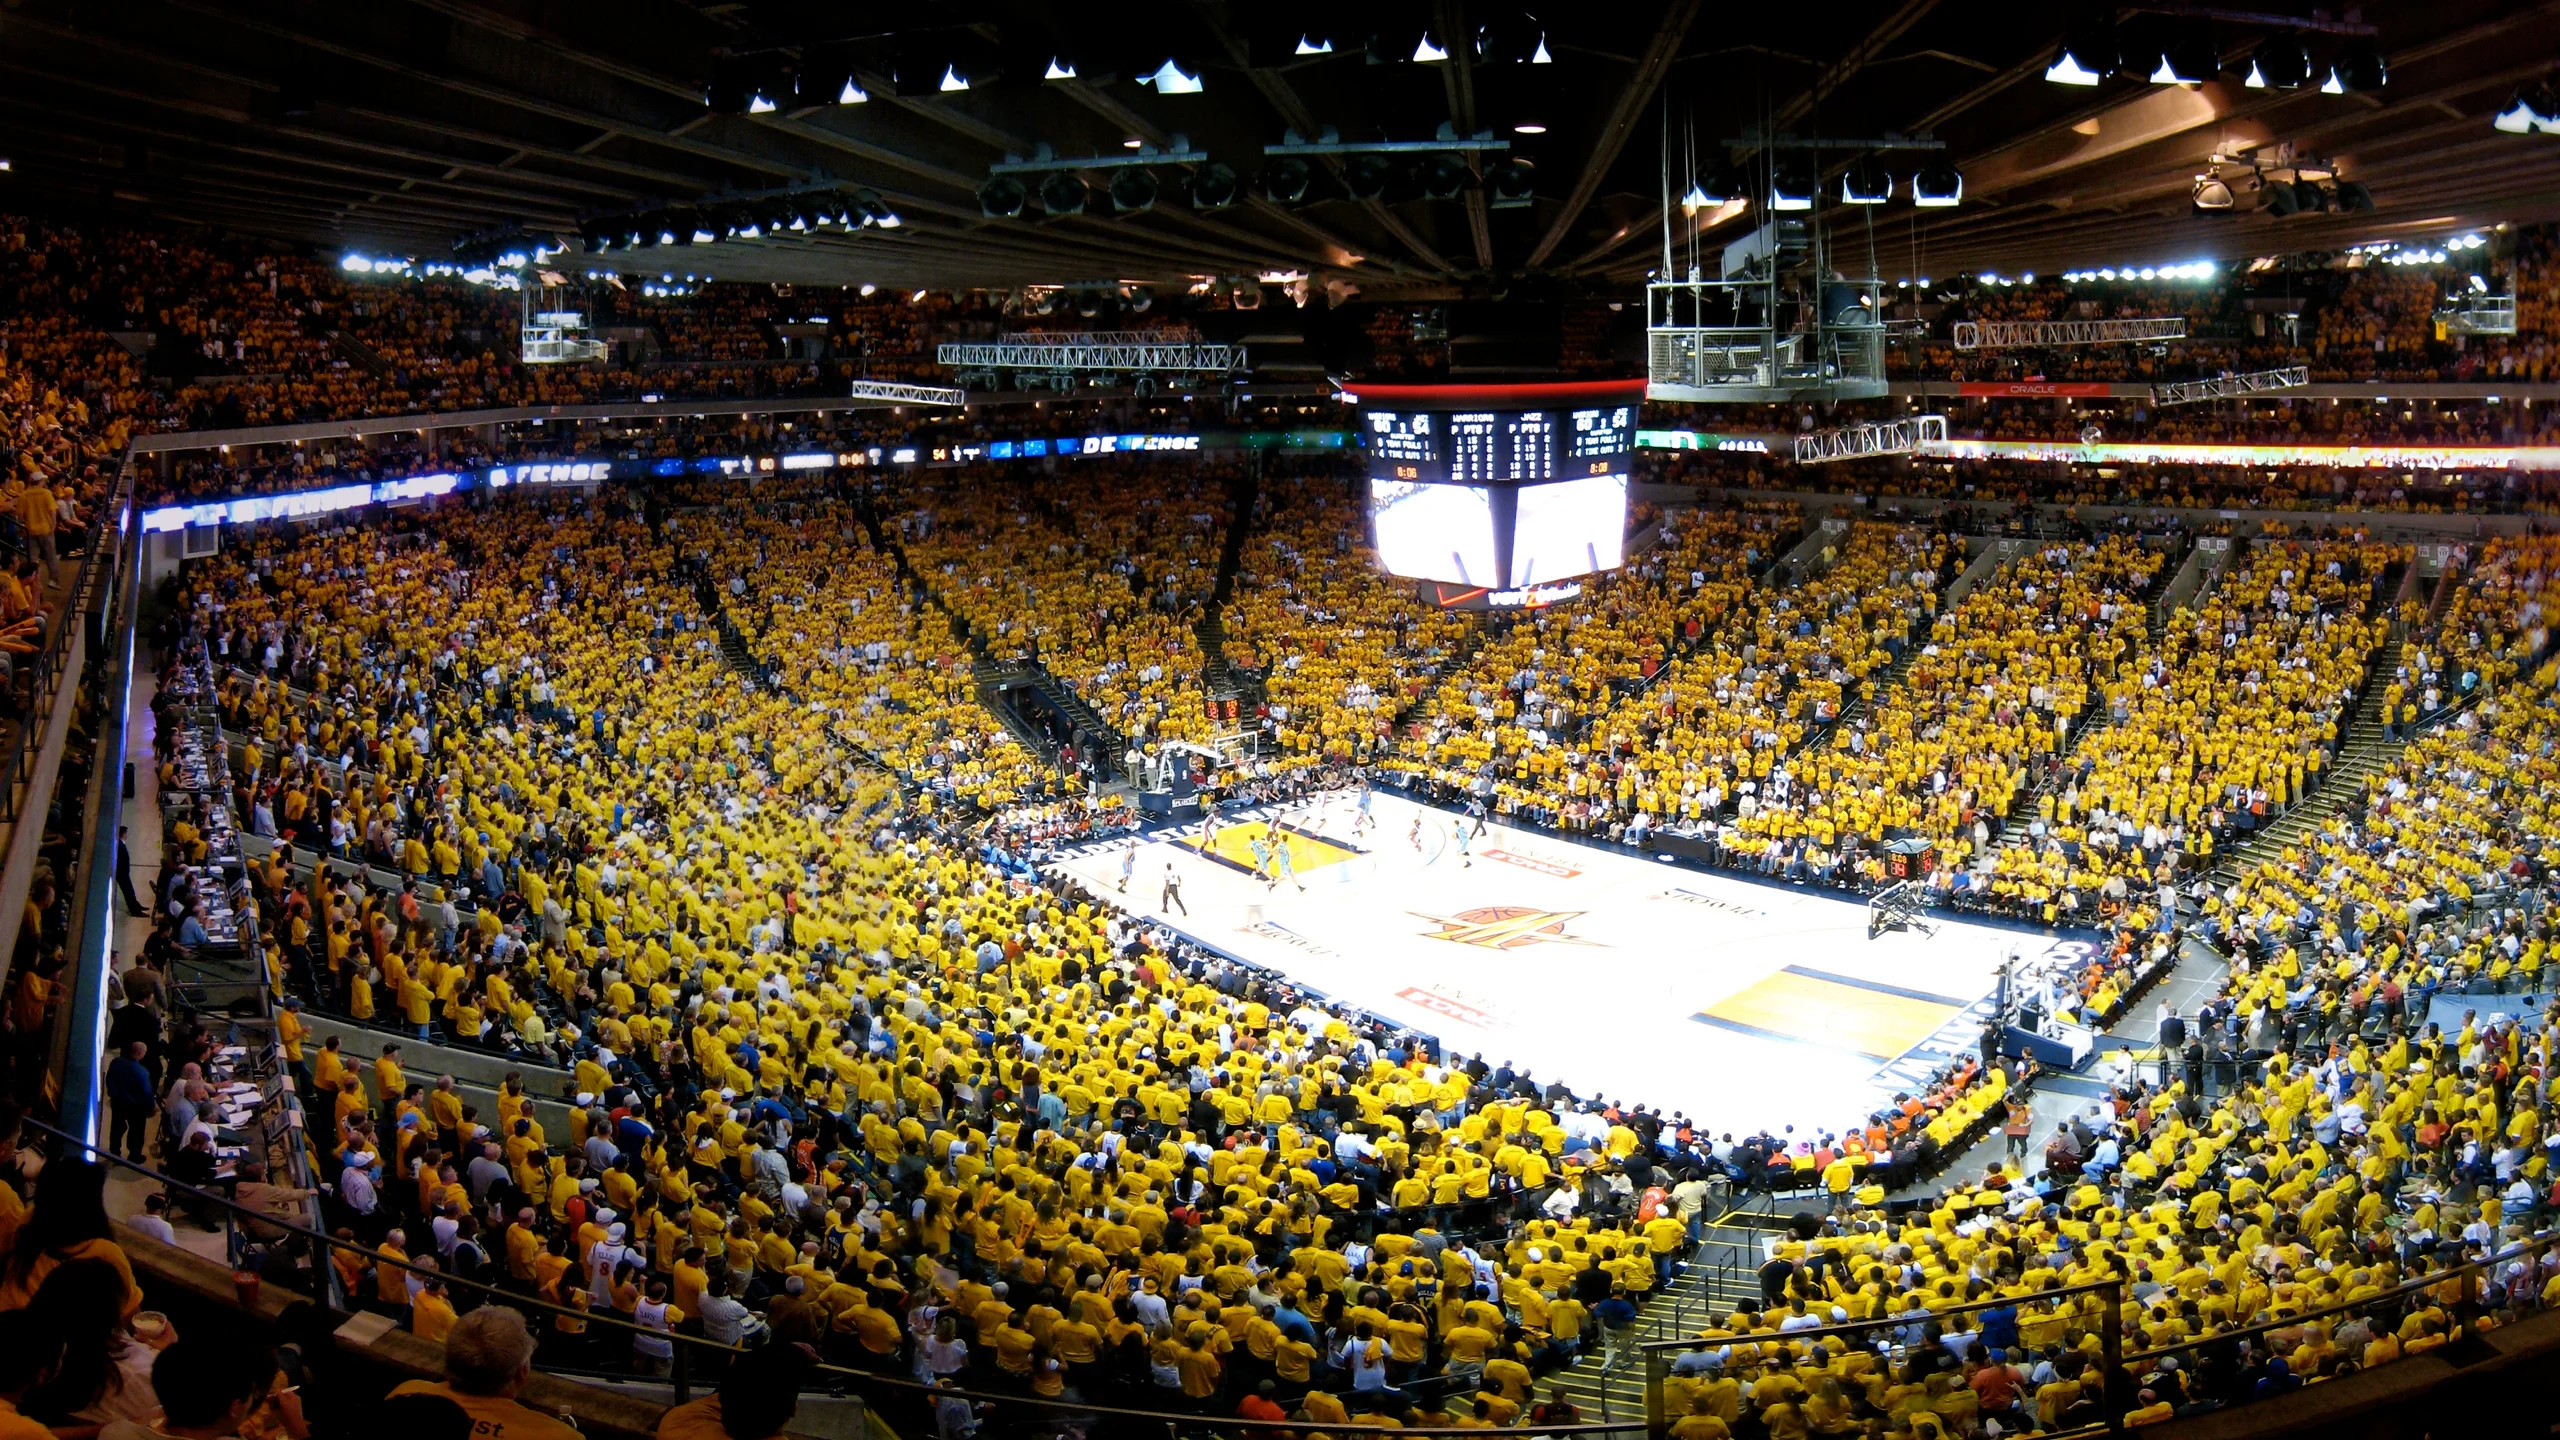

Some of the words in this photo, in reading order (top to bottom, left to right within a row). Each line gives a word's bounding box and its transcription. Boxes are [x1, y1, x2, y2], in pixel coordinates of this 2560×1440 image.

[2010, 385, 2055, 394] ORACLE
[1452, 413, 1495, 422] WARRIORS
[1520, 412, 1543, 422] JAZZ
[1612, 415, 1627, 428] 54
[1412, 421, 1430, 435] 54
[1451, 425, 1459, 435] P
[1463, 424, 1483, 435] PTS
[1486, 424, 1493, 434] F
[1509, 423, 1516, 434] P
[1521, 423, 1541, 434] PTS
[1544, 422, 1551, 433] F
[1083, 437, 1116, 454] DE
[1386, 440, 1402, 449] TEAM
[1402, 441, 1421, 450] FOULS
[1457, 436, 1461, 444] 1
[933, 448, 946, 460] 54
[1467, 445, 1478, 453] 17
[1576, 447, 1582, 458] 4
[1600, 445, 1614, 454] OUTS
[1525, 453, 1536, 461] 10
[517, 463, 611, 483] FENSE
[1544, 470, 1550, 479] 0
[1052, 835, 1150, 862] OLDEN
[1499, 1181, 1507, 1191] 5
[598, 1251, 615, 1262] ELLIS
[600, 1261, 610, 1276] 8
